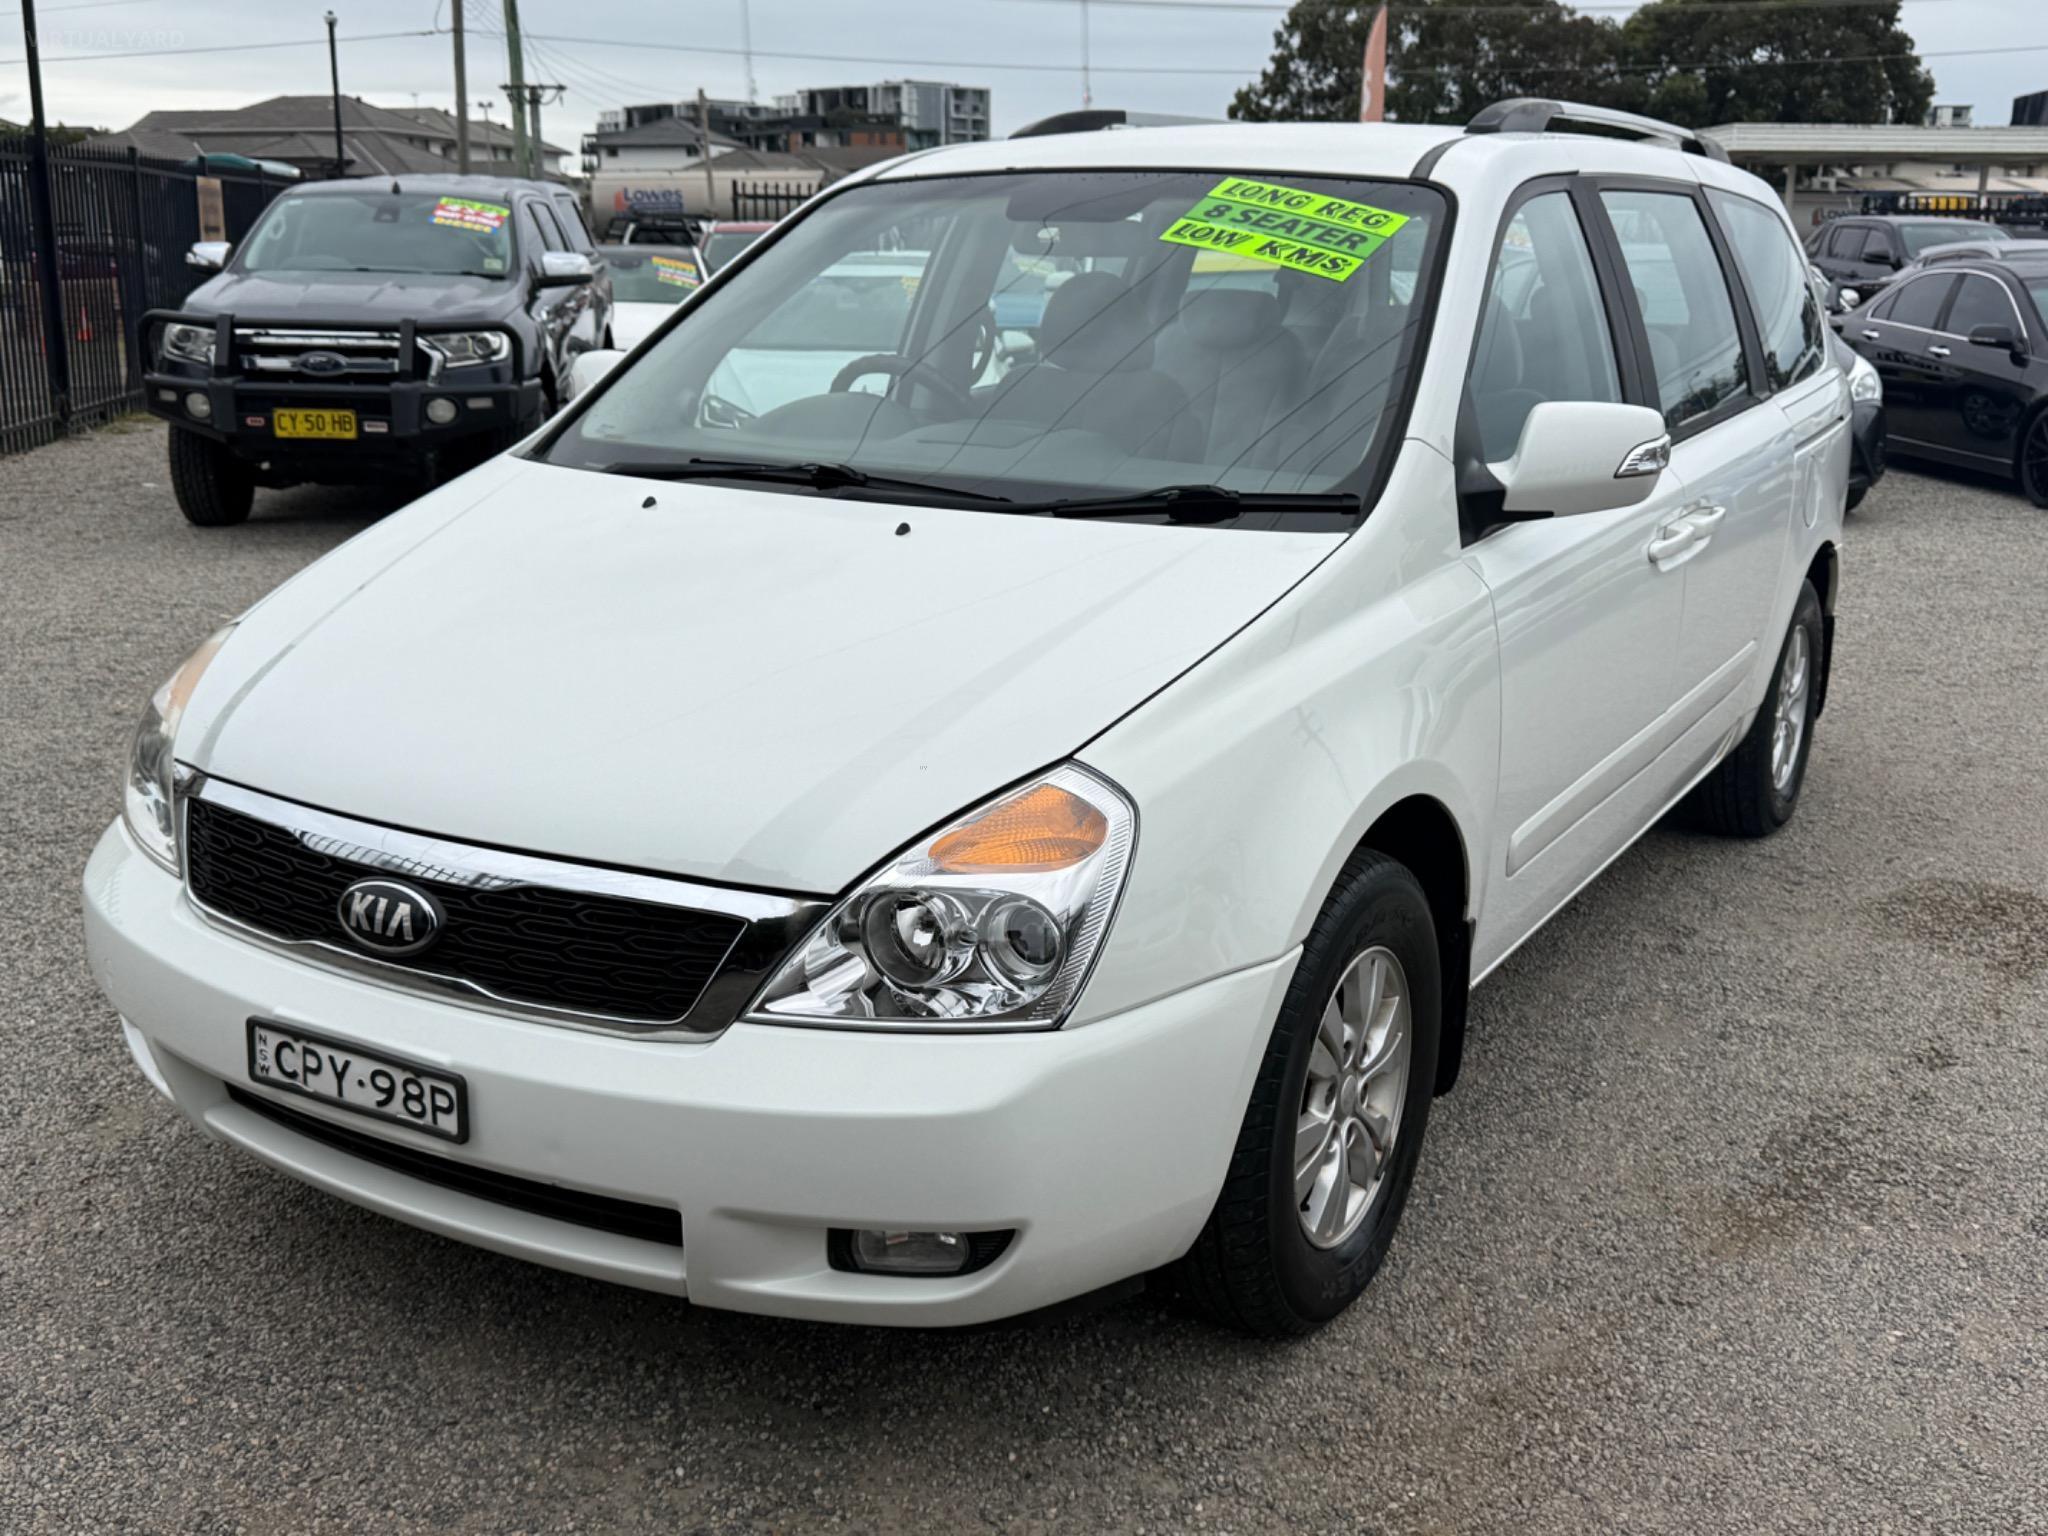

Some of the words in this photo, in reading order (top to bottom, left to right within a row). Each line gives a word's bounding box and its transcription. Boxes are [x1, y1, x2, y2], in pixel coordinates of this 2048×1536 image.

[623, 187, 684, 201] Lowes
[1222, 182, 1314, 209] LONG
[1314, 202, 1393, 228] REG
[1171, 223, 1251, 248] LOW
[1255, 240, 1351, 273] KMS
[1204, 204, 1231, 219] 8
[1232, 207, 1369, 251] SEATER
[277, 412, 297, 431] CY
[350, 891, 414, 941] KIA
